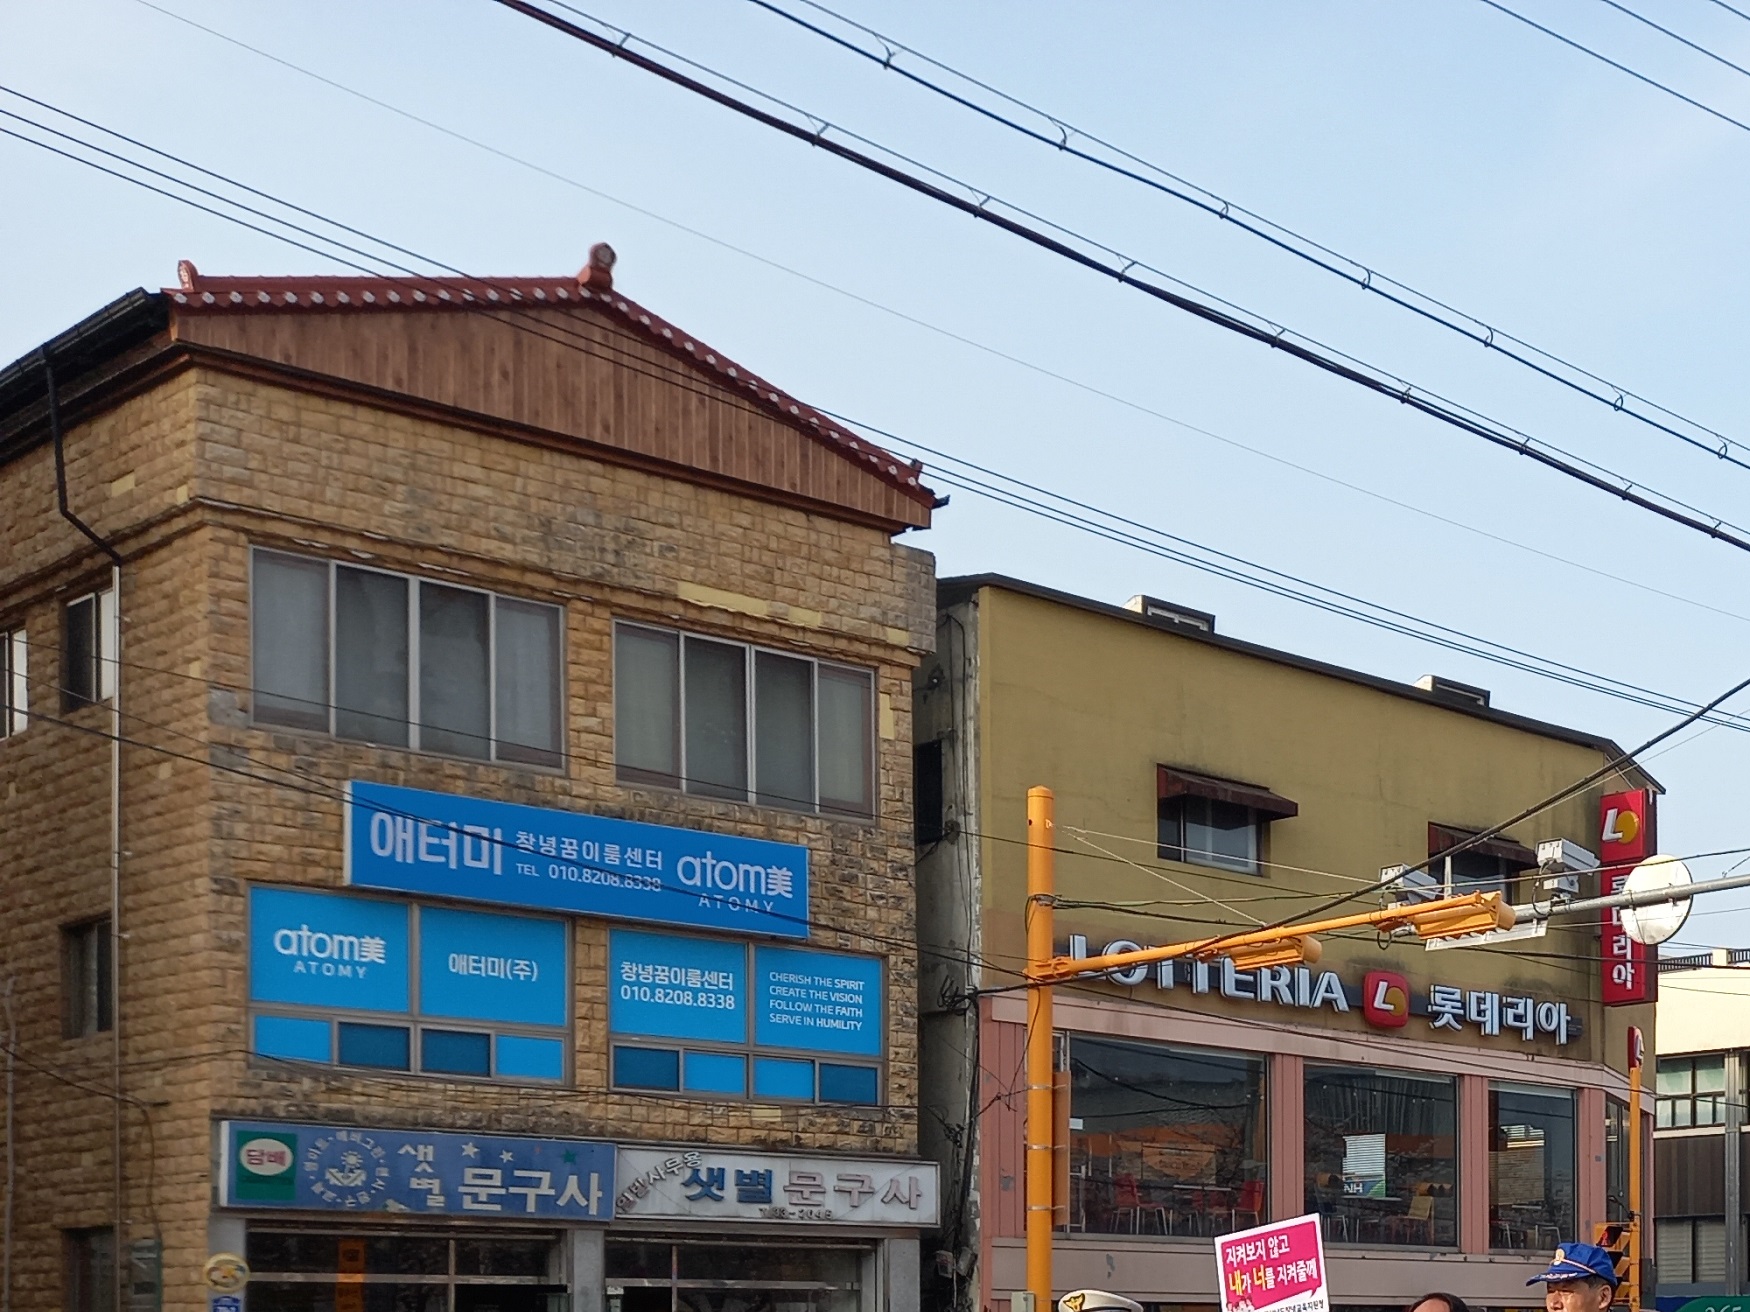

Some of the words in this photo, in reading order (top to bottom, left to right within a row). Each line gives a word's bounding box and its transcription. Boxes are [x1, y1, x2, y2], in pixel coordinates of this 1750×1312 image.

[370, 811, 502, 875] 애터미
[516, 830, 663, 871] 창녕꿈이룸센터
[516, 863, 540, 877] TEL
[549, 863, 661, 892] 010.8208.8338
[698, 894, 775, 914] ATOMY
[293, 961, 367, 979] ATOMY
[449, 953, 538, 982] 애터미(주)
[620, 961, 733, 991] 창녕꿈이룸센터
[769, 971, 811, 985] CHERISH
[814, 975, 833, 988] THE
[834, 979, 865, 991] SPIRIT
[621, 985, 735, 1010] 010.8208.8338
[769, 986, 806, 999] CREATE
[809, 989, 828, 1001] THE
[829, 992, 863, 1005] VISION
[769, 999, 812, 1013] FOLLOW
[814, 1003, 833, 1015] THE
[835, 1005, 863, 1018] FAITH
[769, 1013, 801, 1026] SERVE
[803, 1016, 814, 1027] IN
[816, 1018, 863, 1031] HUMILITY
[1428, 985, 1571, 1045] 롯데리아
[398, 1143, 445, 1207] 샛별
[681, 1167, 773, 1205] 샛별
[783, 1170, 923, 1210] 문구사
[457, 1167, 602, 1216] 문구사
[1225, 1239, 1267, 1267] 지켜보지
[1268, 1234, 1290, 1259] 않고
[1228, 1269, 1251, 1296] 내가
[1252, 1264, 1275, 1291] 너를
